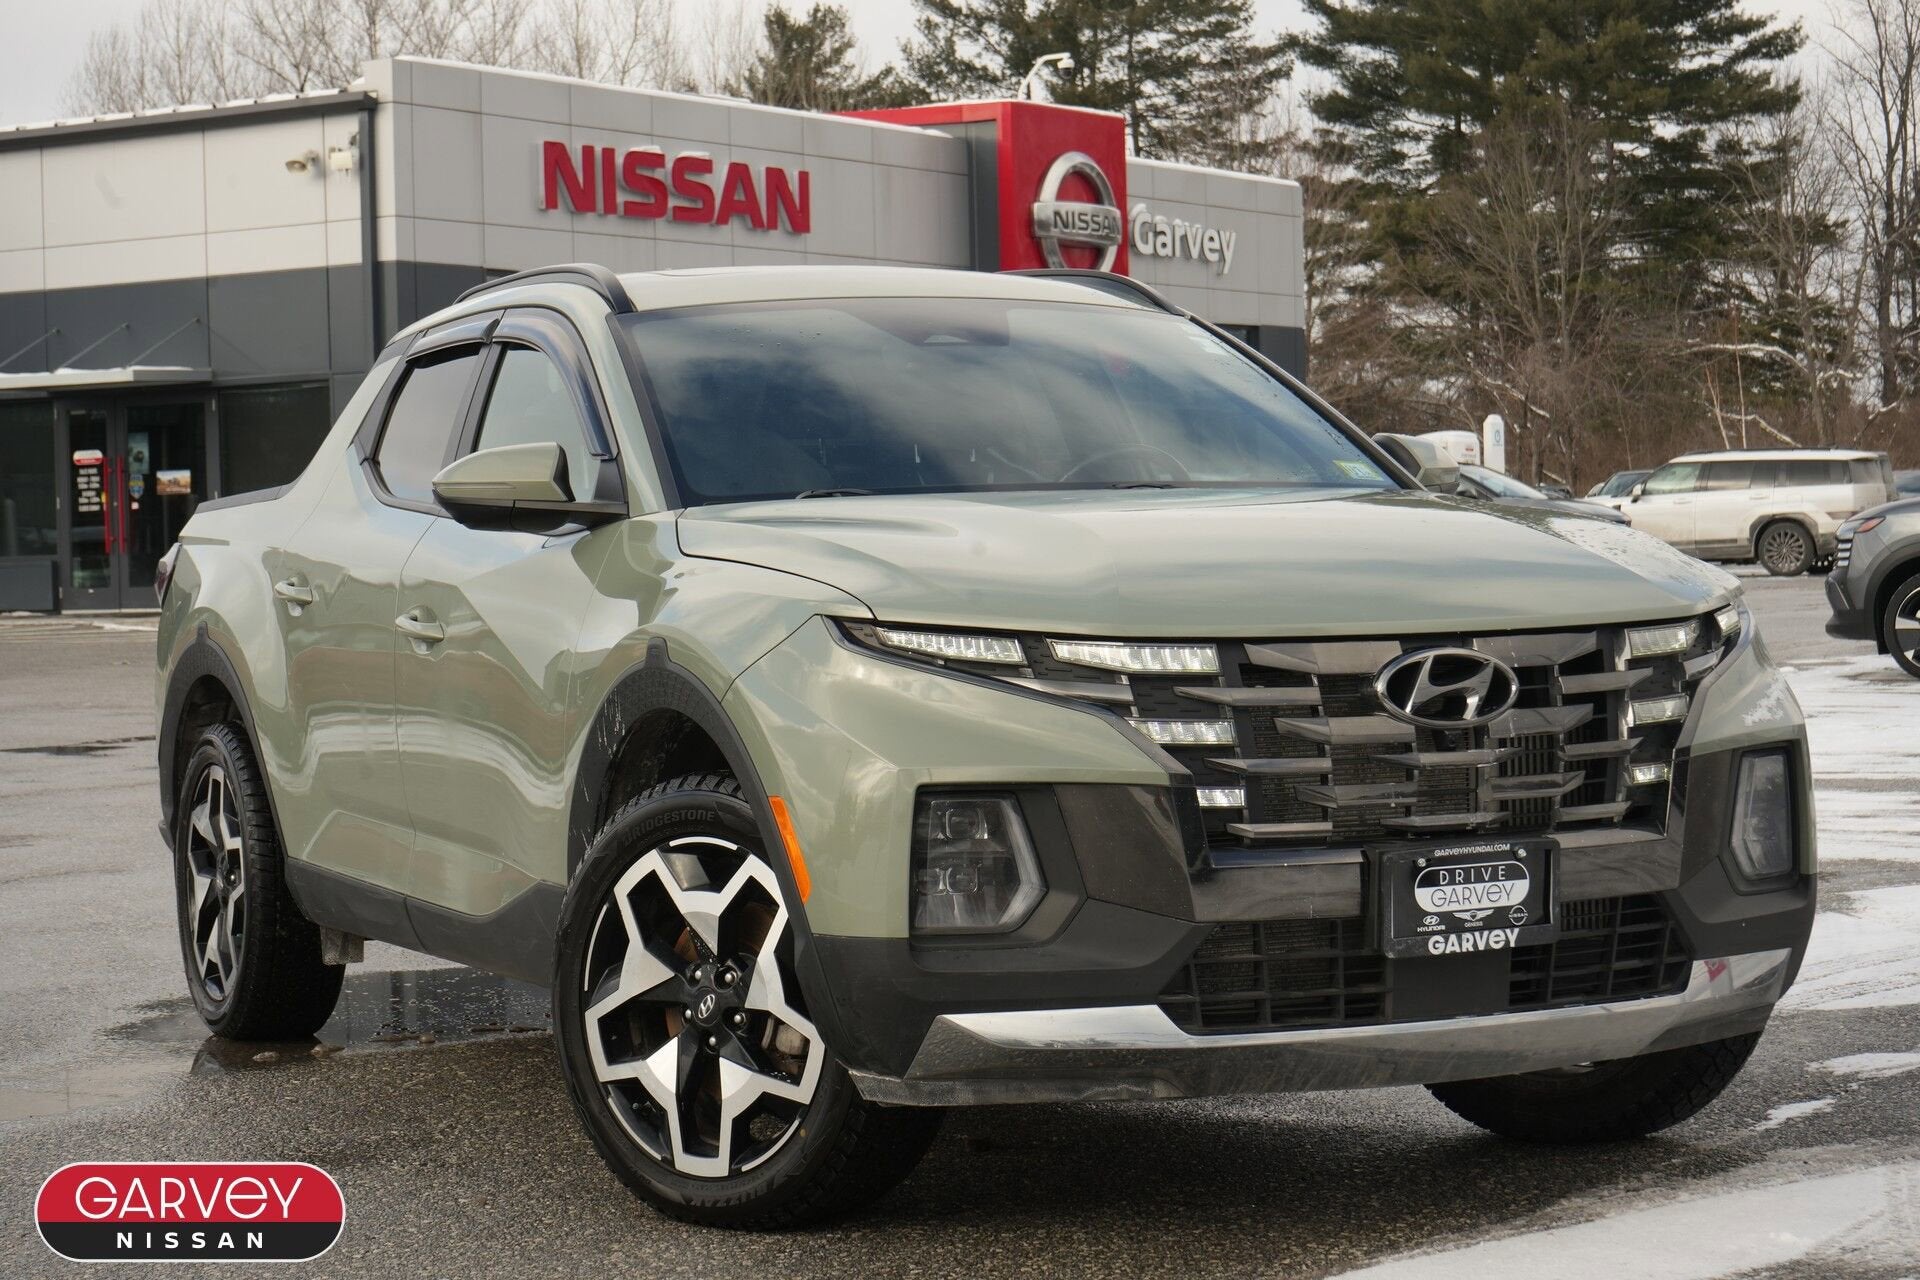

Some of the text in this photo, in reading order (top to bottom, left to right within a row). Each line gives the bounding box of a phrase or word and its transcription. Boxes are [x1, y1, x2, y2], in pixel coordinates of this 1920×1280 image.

[542, 141, 811, 234] NISSAN
[1053, 209, 1120, 237] NISSAN
[1132, 209, 1236, 275] Garvey
[1439, 865, 1506, 885] DRIVE
